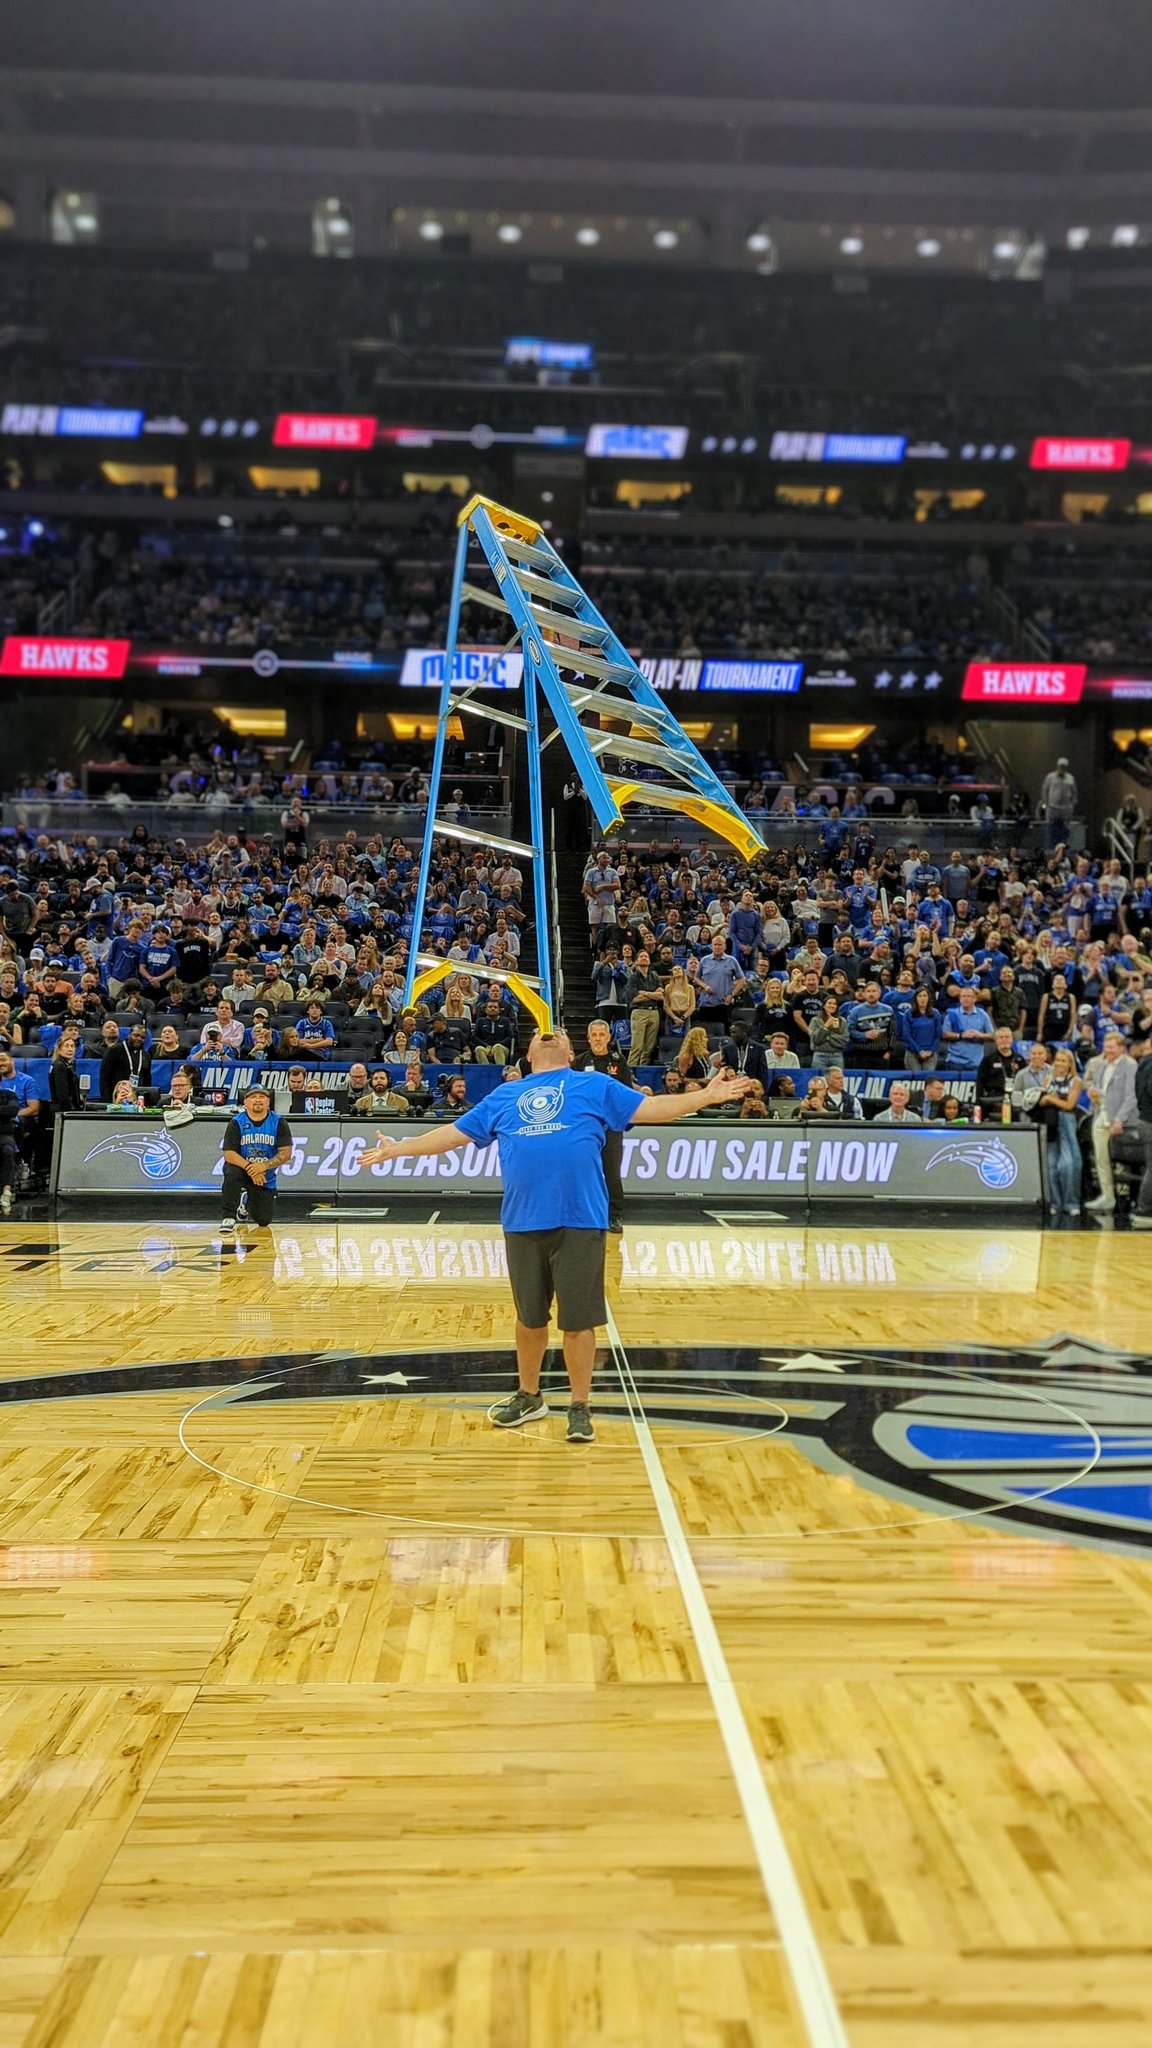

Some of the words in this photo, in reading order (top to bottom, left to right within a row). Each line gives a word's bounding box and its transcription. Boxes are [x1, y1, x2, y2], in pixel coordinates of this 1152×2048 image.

[290, 418, 360, 443] HAWKS
[1046, 443, 1114, 465] HAWKS
[20, 643, 109, 671] HAWKS
[158, 664, 201, 676] HAWKS
[421, 652, 507, 689] MAGIC
[639, 659, 702, 690] PLAY-IN
[705, 662, 799, 690] TOURNAMENT
[982, 670, 1066, 695] HAWKS
[241, 1133, 274, 1146] ORLANDO
[667, 1139, 717, 1180] ON
[722, 1140, 811, 1181] SALE
[815, 1142, 898, 1182] NOW
